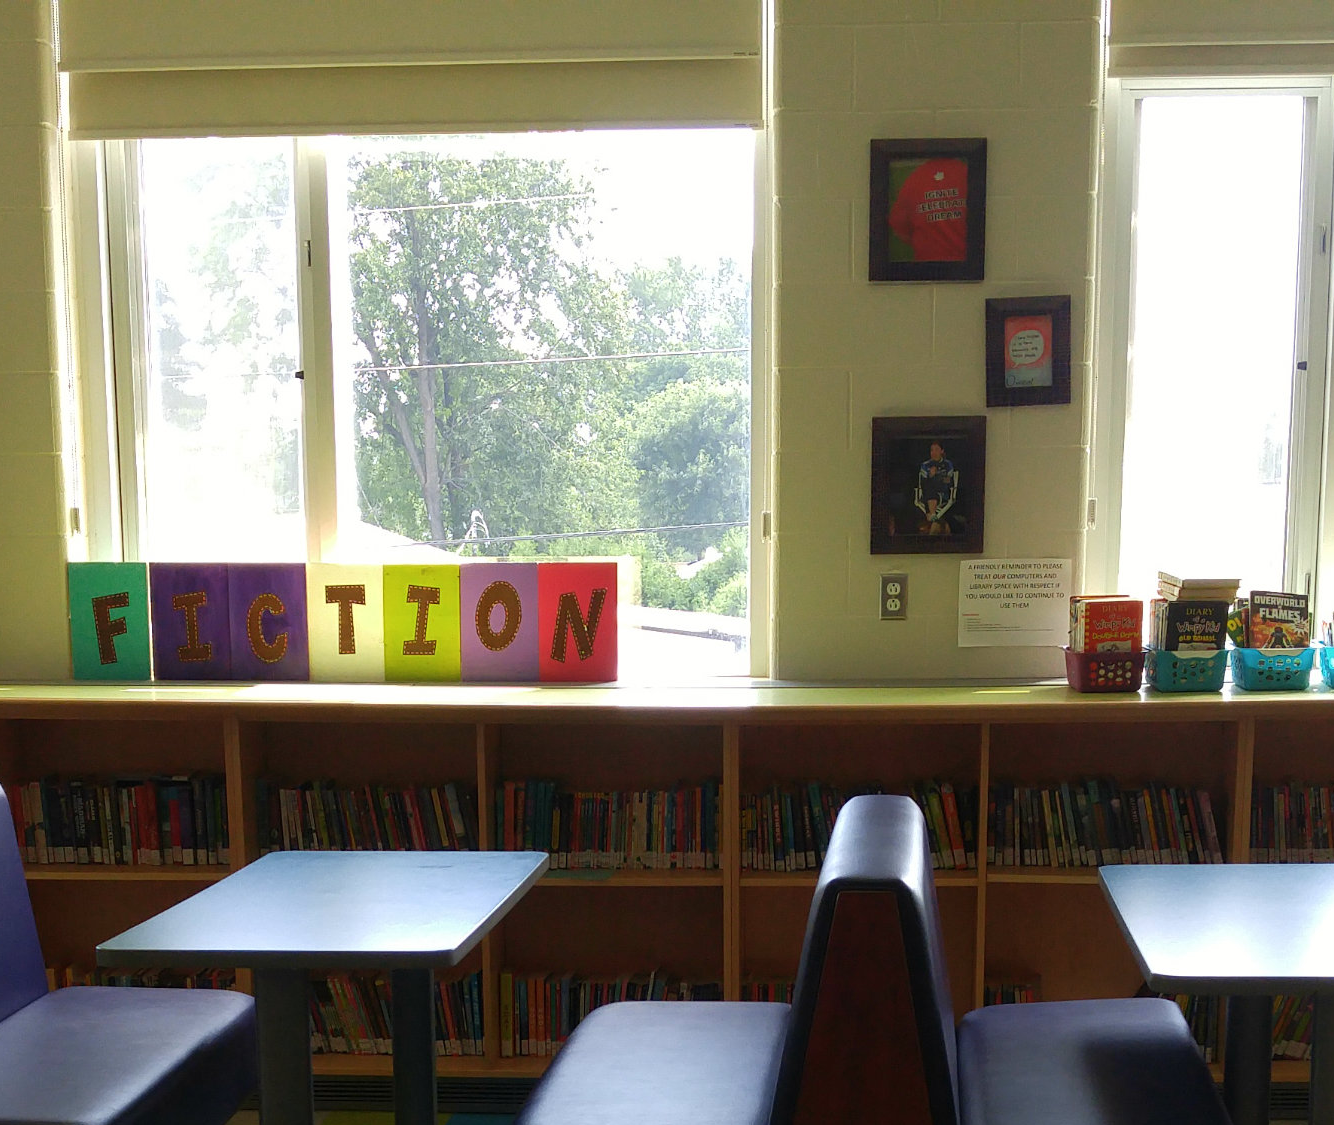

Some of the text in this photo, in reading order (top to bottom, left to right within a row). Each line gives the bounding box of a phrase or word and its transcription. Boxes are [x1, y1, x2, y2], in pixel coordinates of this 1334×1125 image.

[925, 189, 958, 200] IGNITE
[927, 211, 962, 222] DREAM
[1254, 595, 1306, 608] OVERWORLD
[1186, 607, 1215, 616] DIARY
[1260, 607, 1301, 621] FLAMES
[92, 580, 608, 665] FICTION
[1176, 621, 1206, 635] Wimpy
[1205, 620, 1221, 633] Kid
